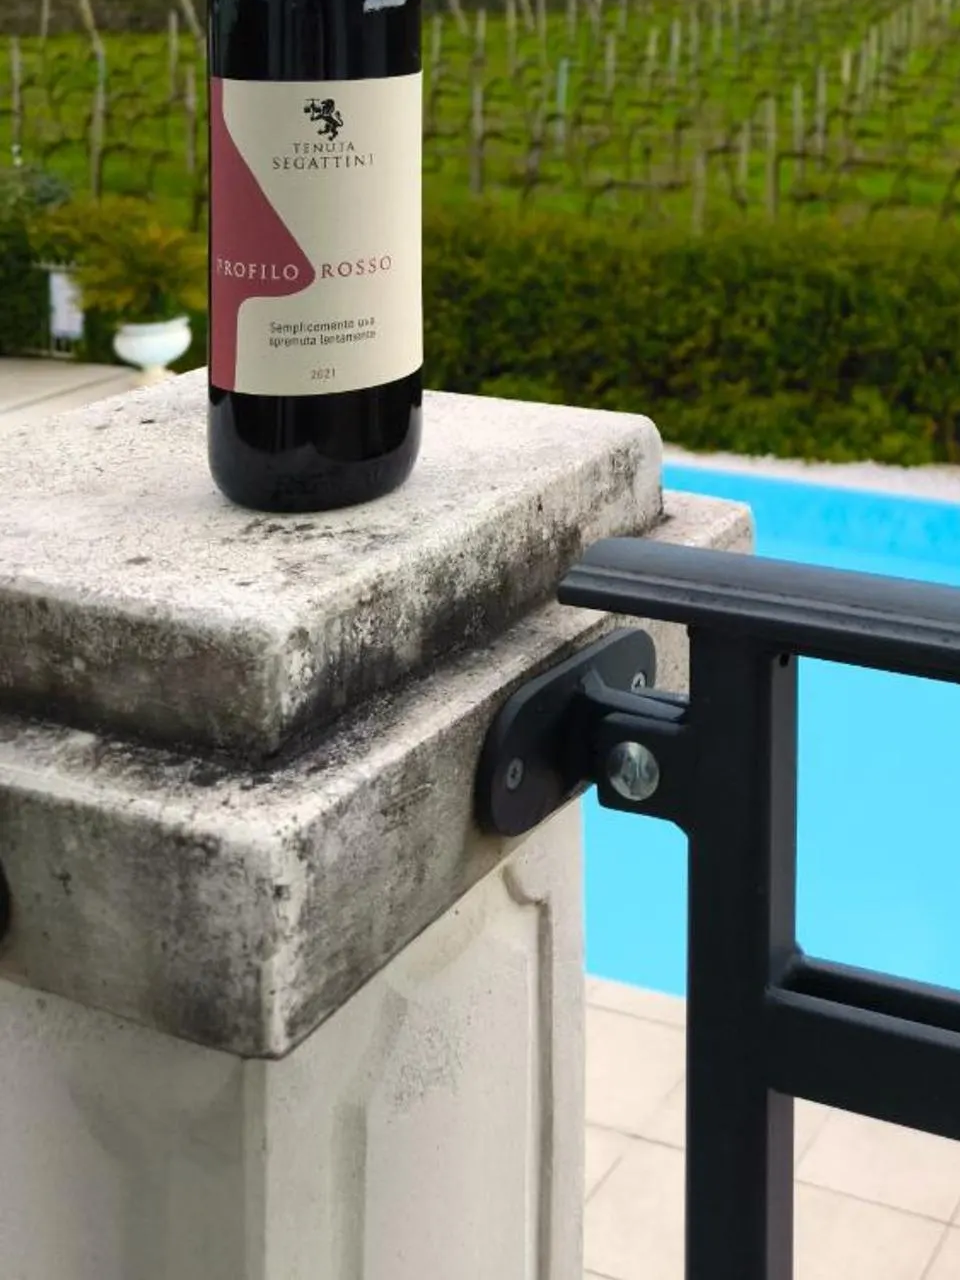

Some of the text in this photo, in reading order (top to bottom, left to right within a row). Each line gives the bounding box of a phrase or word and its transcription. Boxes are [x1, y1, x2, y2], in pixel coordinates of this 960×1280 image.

[293, 142, 355, 154] TENUTA
[272, 154, 374, 169] SEGATTINI
[321, 255, 392, 278] ROSSO
[310, 367, 336, 380] 2021
